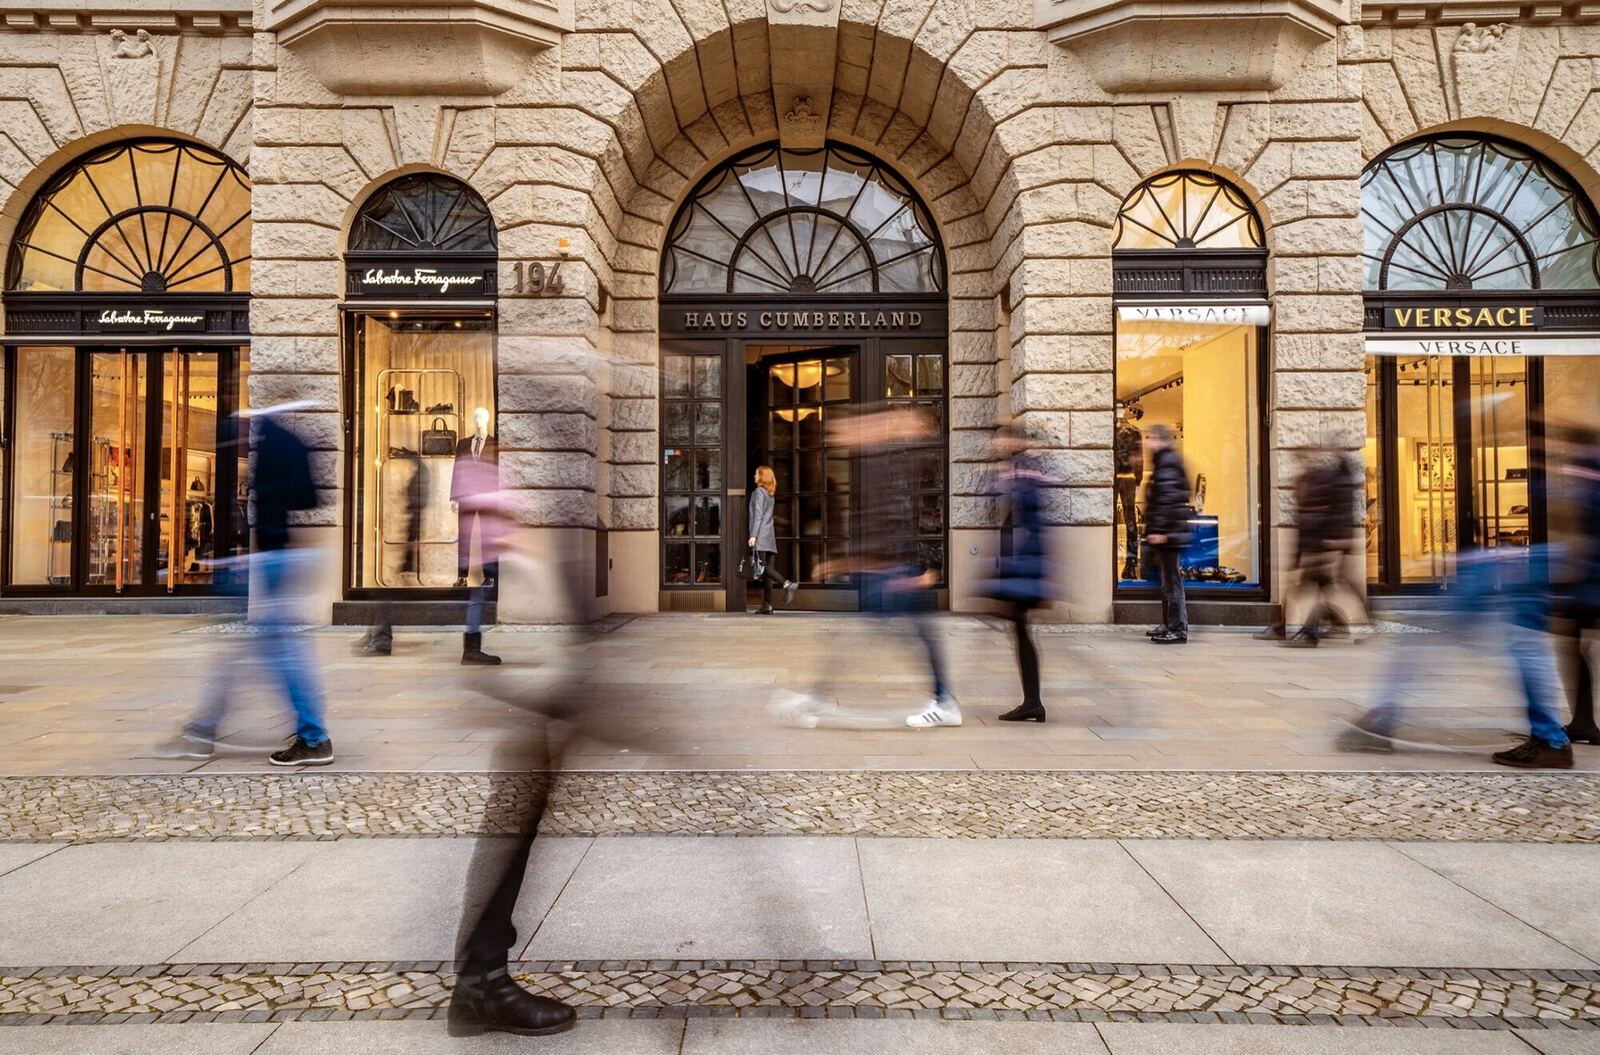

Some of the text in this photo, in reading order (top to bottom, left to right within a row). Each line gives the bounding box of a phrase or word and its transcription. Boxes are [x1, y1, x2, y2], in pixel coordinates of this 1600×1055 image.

[362, 268, 482, 293] Salvatore Ferragamo
[512, 261, 564, 295] 194
[98, 309, 204, 331] Salvatore Ferragamo
[685, 312, 923, 329] HAUS CUMBERLAND
[1394, 306, 1535, 328] VERSACE
[1419, 341, 1523, 354] VERSACE
